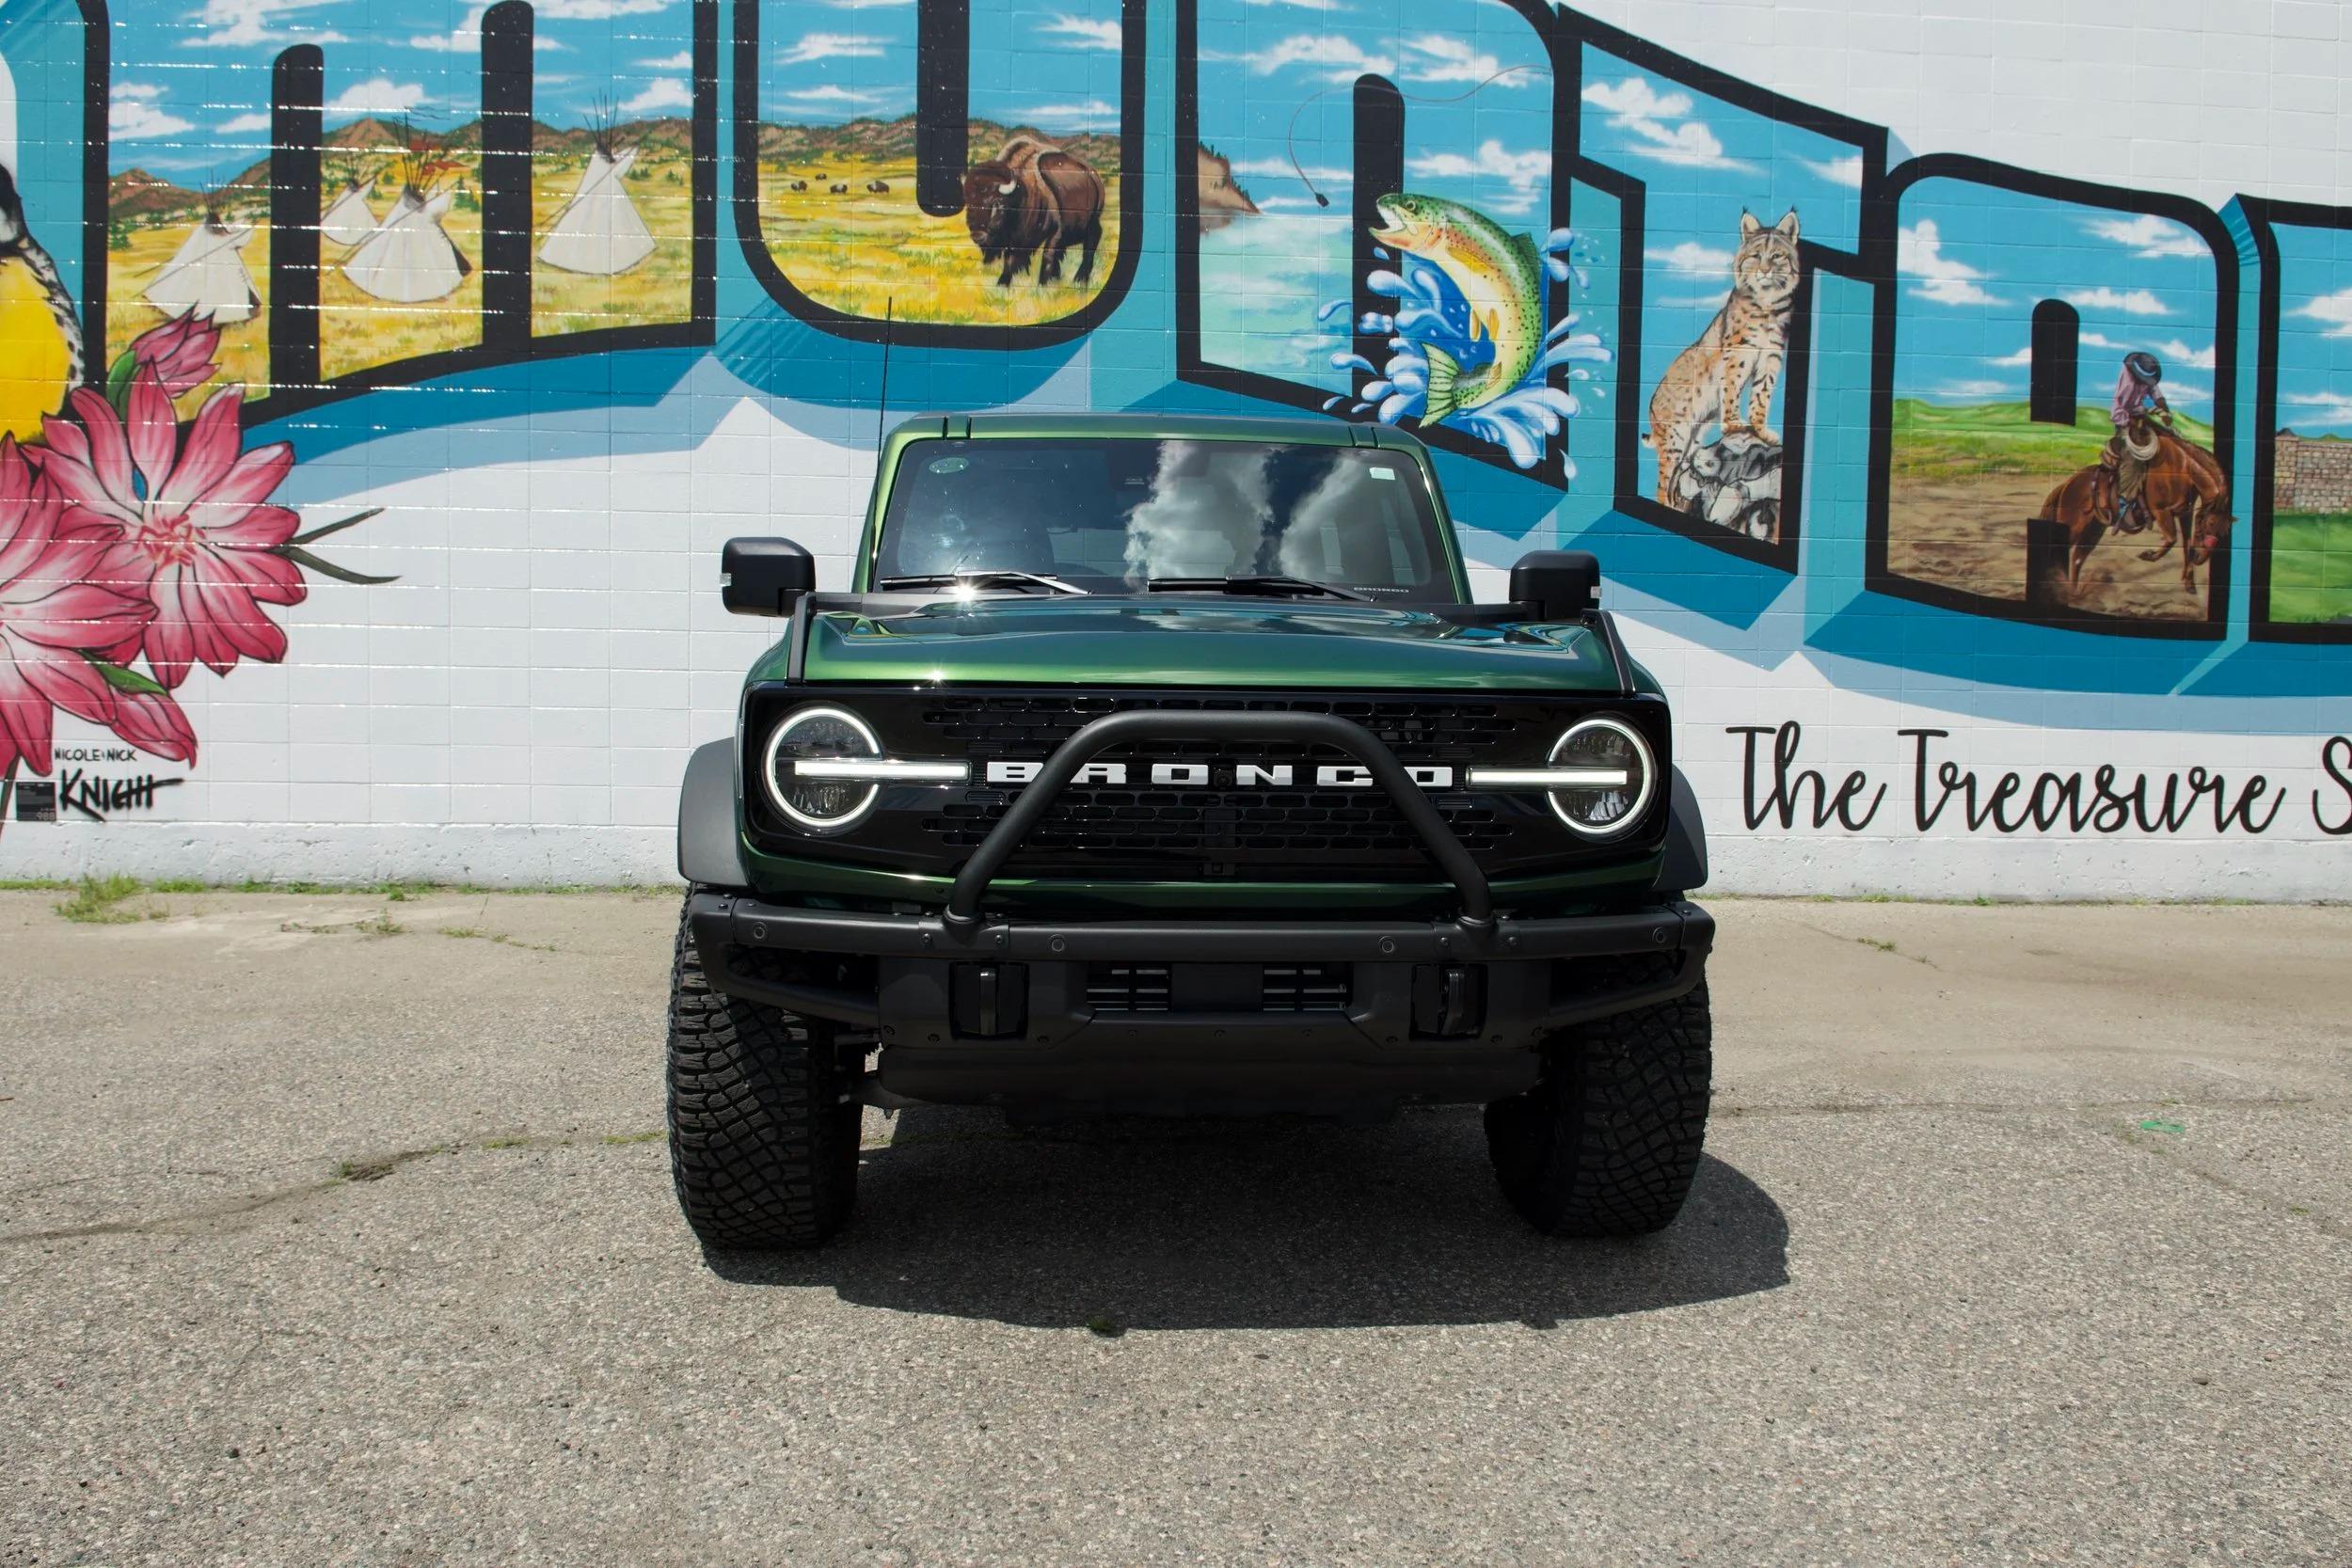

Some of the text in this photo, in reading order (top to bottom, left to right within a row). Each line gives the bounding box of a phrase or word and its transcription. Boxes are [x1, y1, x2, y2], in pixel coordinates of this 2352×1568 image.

[986, 762, 1453, 786] BRONCO
[1725, 721, 1887, 832] The
[1897, 729, 2286, 834] Treasure
